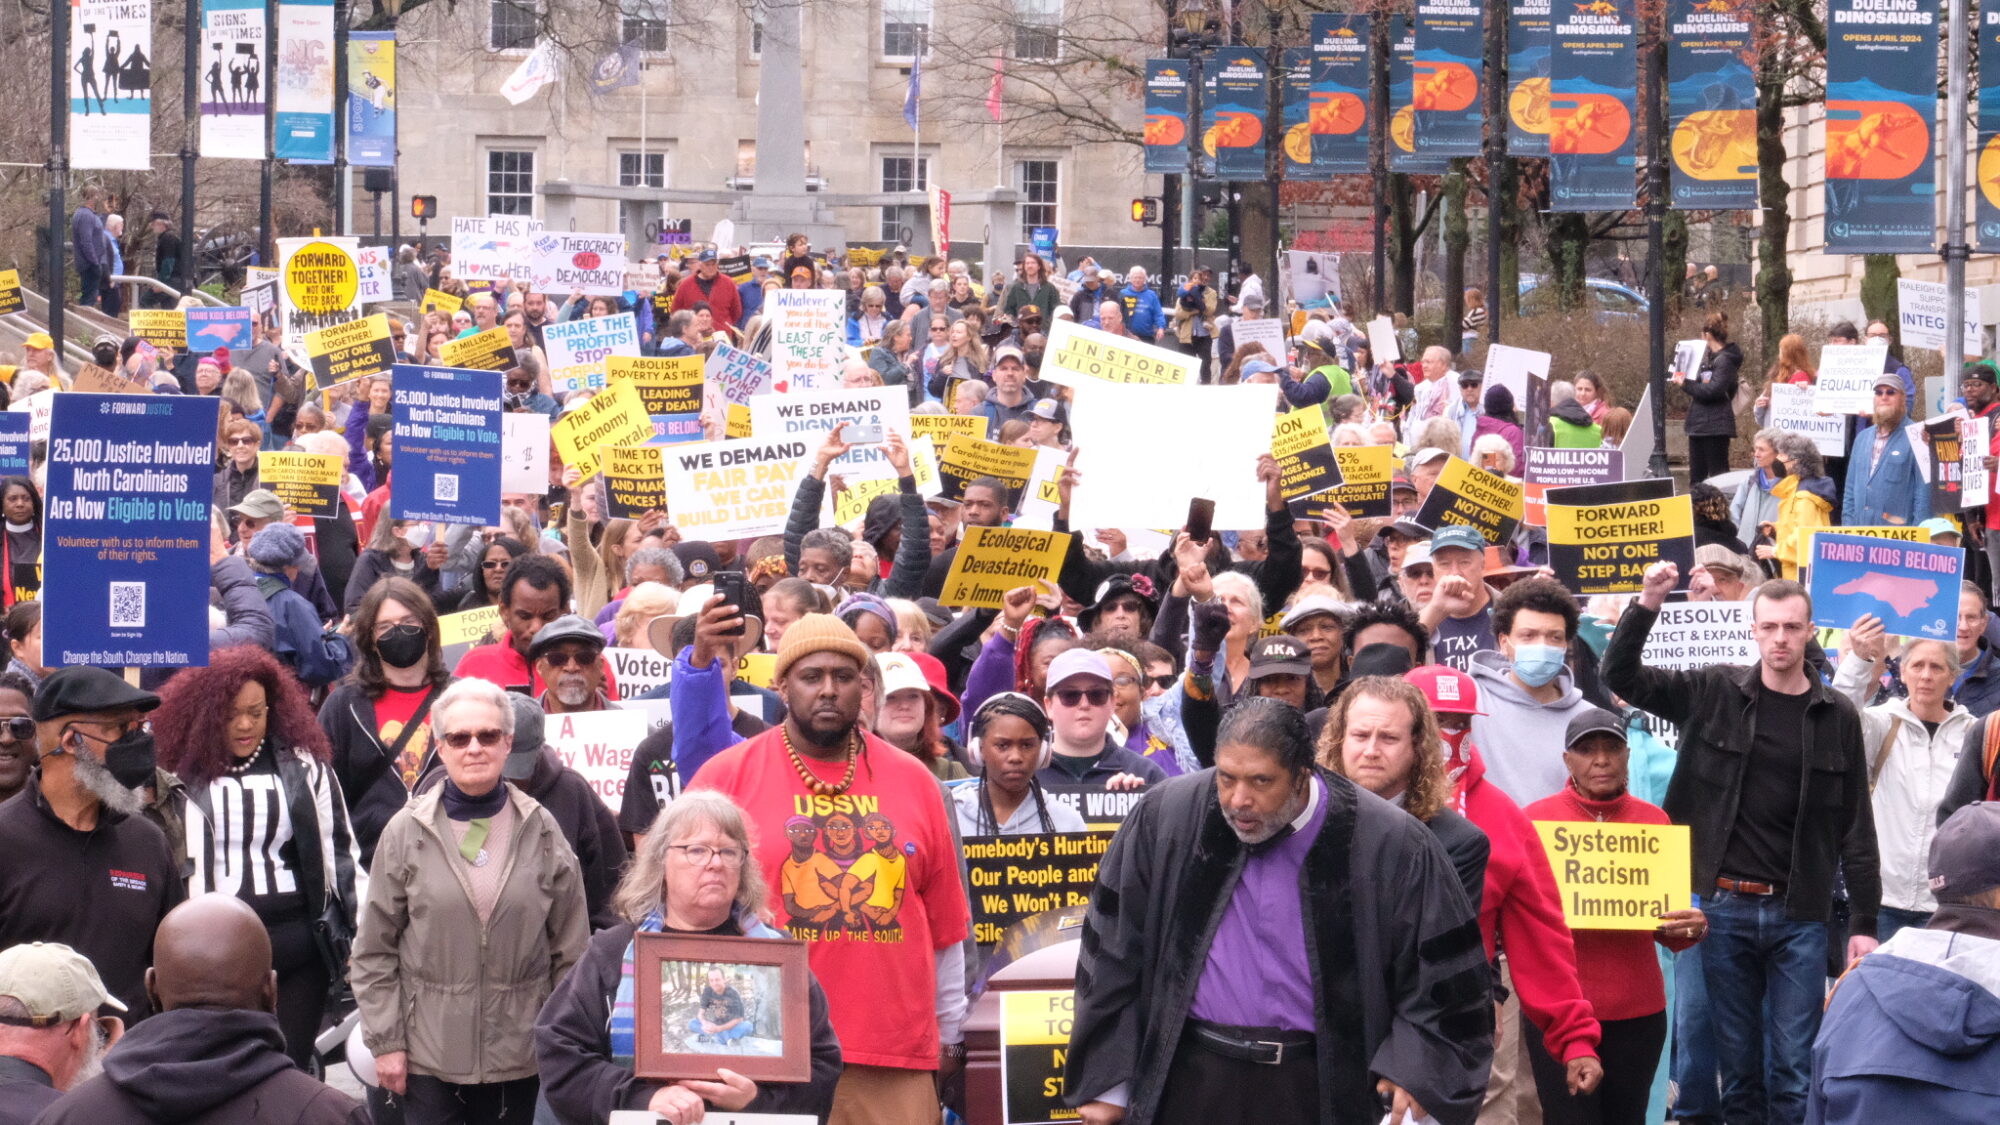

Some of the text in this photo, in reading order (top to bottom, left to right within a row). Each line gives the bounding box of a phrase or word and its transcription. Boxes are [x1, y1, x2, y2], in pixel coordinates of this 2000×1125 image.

[109, 4, 147, 20] TIMES
[1419, 6, 1480, 15] DINOSAURS
[1852, 0, 1917, 10] DUELING
[214, 14, 247, 26] SIGNS
[1834, 10, 1933, 24] DINOSAURS
[229, 28, 262, 40] TIMES
[1556, 24, 1632, 35] DINOSAURS
[1673, 23, 1749, 34] DINOSAURS
[1842, 34, 1897, 42] OPENS APRIL
[455, 219, 520, 236] HATE HAS
[663, 219, 684, 230] MY
[561, 237, 623, 256] THEOCRACY
[294, 252, 347, 268] FORWARD
[291, 269, 348, 285] TOGETHER!
[556, 269, 621, 286] DEMOCRACY
[306, 284, 335, 295] NOT ONE
[1900, 281, 1936, 296] RALEIGH
[777, 292, 830, 307] Whatever
[320, 320, 369, 340] FORWARD
[546, 316, 631, 340] SHARE THE
[322, 330, 374, 351] TOGETHER!
[459, 332, 498, 351] MILLION
[567, 330, 633, 352] PROFITS!
[777, 330, 836, 345] LEAST OF
[329, 343, 373, 362] NOT ONE
[575, 348, 612, 364] STOP
[717, 344, 739, 362] WE
[787, 346, 824, 360] THESE
[329, 353, 382, 375] STEP BACK!
[632, 360, 679, 370] ABOLISH
[611, 368, 699, 380] POVERTY AS THE
[724, 363, 762, 388] FAIR
[1820, 378, 1876, 392] EQUALITY
[395, 389, 501, 412] 25,000 Justice Involved
[642, 388, 692, 400] LEADING
[566, 391, 618, 431] The War
[647, 400, 701, 412] OF DEATH
[777, 400, 882, 418] WE DEMAND
[409, 407, 487, 427] North Carolinians
[935, 418, 975, 428] TO TAKE
[395, 422, 501, 444] Are Now Eligible to Vote.
[573, 410, 630, 452] Economy
[1773, 418, 1842, 433] COMMUNITY
[53, 438, 213, 466] 25,000 Justice Involved
[612, 448, 659, 460] TIME TO
[952, 446, 1000, 464] Carolinians
[1000, 448, 1021, 457] North
[1964, 440, 1978, 456] FOR
[279, 457, 326, 469] MILLION
[679, 442, 807, 471] WE DEMAND
[1547, 452, 1609, 465] MILLION
[579, 462, 593, 476] is
[613, 464, 644, 474] BACK
[693, 461, 798, 491] FAIR PAY
[973, 462, 1016, 475] low-income
[1358, 464, 1374, 472] ARE
[1557, 467, 1608, 476] LOW-INCOME
[73, 467, 188, 494] North Carolinians
[611, 480, 634, 491] AND
[1467, 468, 1519, 498] FORWARD
[1964, 474, 1983, 492] LIVES
[710, 485, 785, 506] WE CAN
[1312, 492, 1385, 503] THE ELECTORATE!
[1341, 486, 1375, 494] POWER
[1459, 480, 1514, 512] TOGETHER!
[614, 494, 656, 506] VOICES
[49, 496, 209, 524] Are Now Eligible to Vote.
[677, 502, 788, 528] BUILD LIVES
[1454, 498, 1502, 527] NOT ONE
[1576, 503, 1660, 522] FORWARD
[1574, 521, 1665, 539] TOGETHER!
[57, 536, 200, 550] Volunteer with us to inform them
[978, 528, 1054, 553] Ecological
[109, 550, 158, 565] their rights.
[1583, 544, 1659, 560] NOT ONE
[1820, 542, 1958, 574] TRANS KIDS BELONG
[961, 555, 1050, 580] Devastation
[1577, 565, 1616, 579] STEP
[953, 582, 968, 601] is
[1660, 609, 1742, 625] RESOLVE
[1690, 630, 1700, 641] &
[1262, 644, 1297, 656] AKA
[1442, 634, 1478, 654] TAX
[1688, 646, 1749, 658] RIGHTS &
[63, 650, 190, 666] Change the Change Nation.
[559, 715, 575, 740] A
[794, 794, 879, 818] USSW
[1554, 826, 1660, 857] Systemic
[970, 863, 1099, 888] Our People and
[1565, 859, 1650, 886] Racism
[981, 893, 1062, 914] We Won't
[1573, 891, 1669, 918] Immoral
[824, 928, 903, 944] UP THE SOUTH
